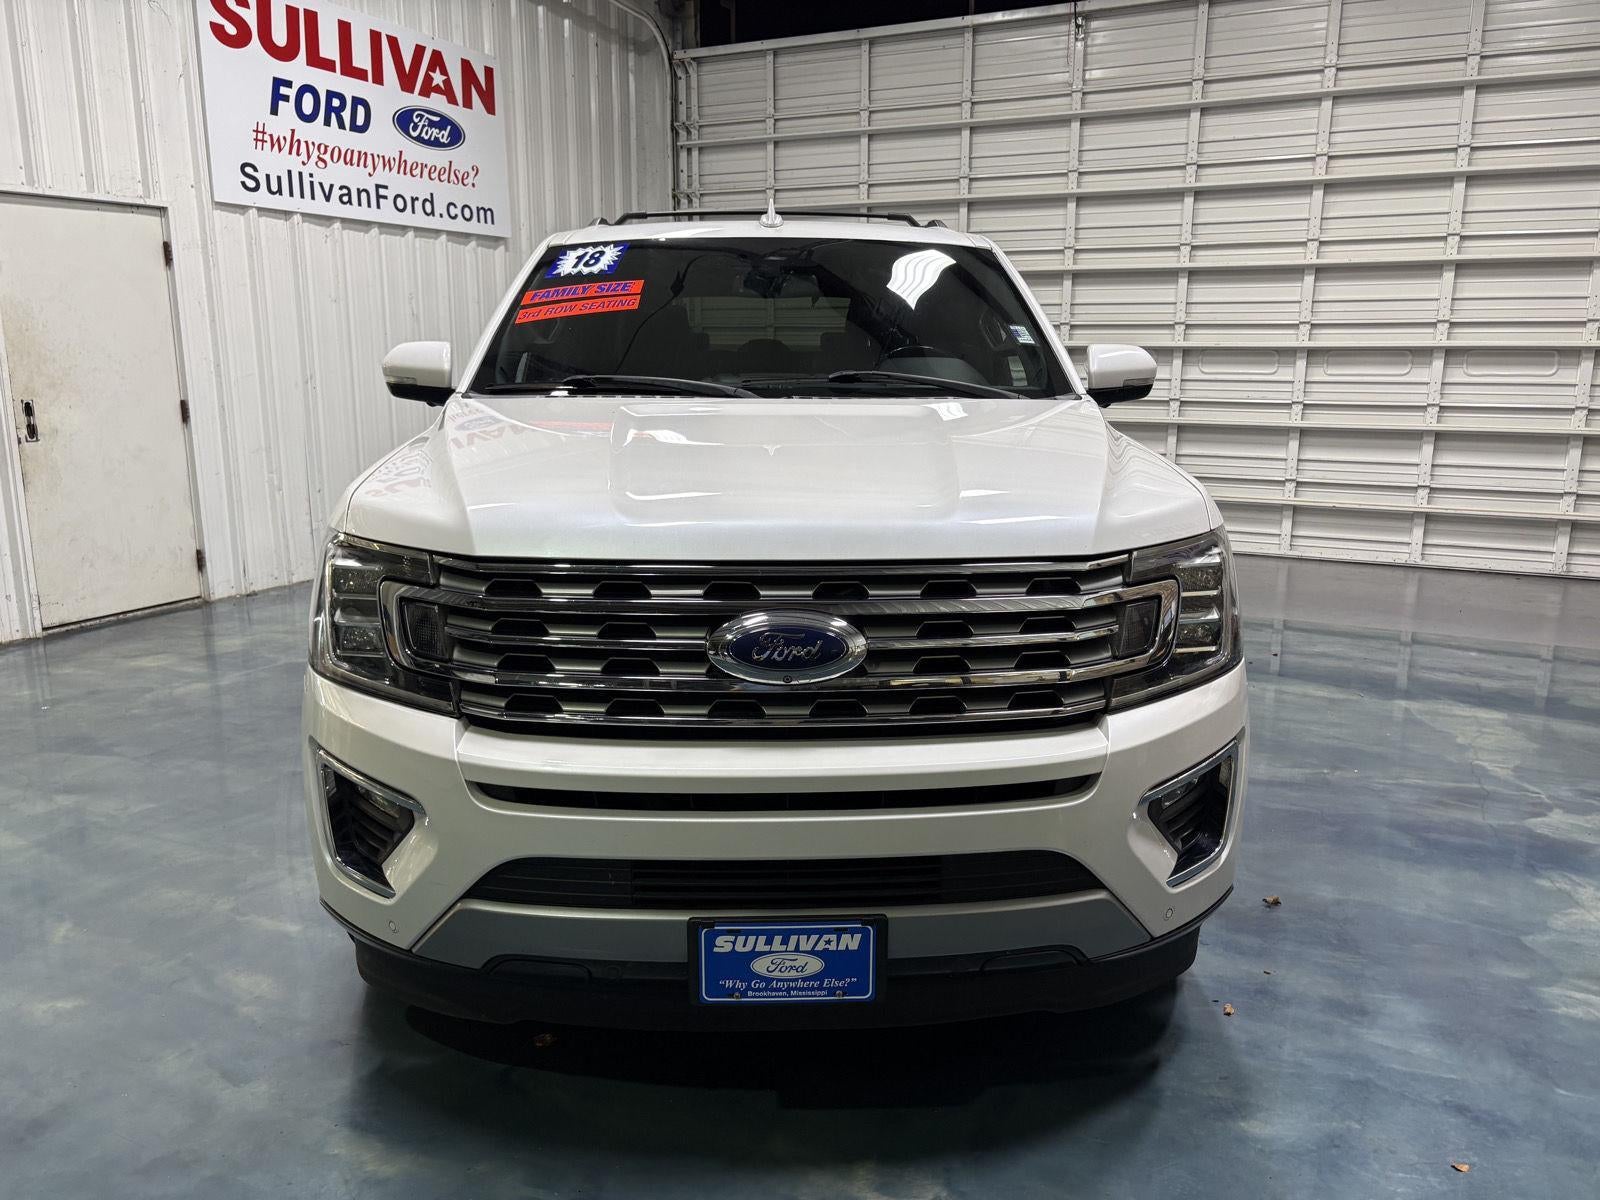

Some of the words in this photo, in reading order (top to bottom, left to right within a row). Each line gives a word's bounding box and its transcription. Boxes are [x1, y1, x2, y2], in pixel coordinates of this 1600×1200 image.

[209, 0, 496, 116] SULLIVAN
[269, 76, 371, 134] FORD
[409, 110, 451, 144] Ford
[252, 121, 480, 188] #whygoanywhereelse?
[239, 161, 495, 226] SullivanFord.com
[571, 250, 606, 269] 18
[530, 286, 593, 301] FAMILY
[594, 282, 633, 294] SIZE
[518, 310, 540, 321] 3rd
[544, 304, 577, 316] ROW
[579, 298, 637, 311] SEATING
[752, 631, 823, 662] Ford
[713, 933, 862, 952] SULLIVAN
[766, 957, 808, 974] Ford
[751, 979, 766, 989] Go
[769, 979, 820, 990] Anywhere
